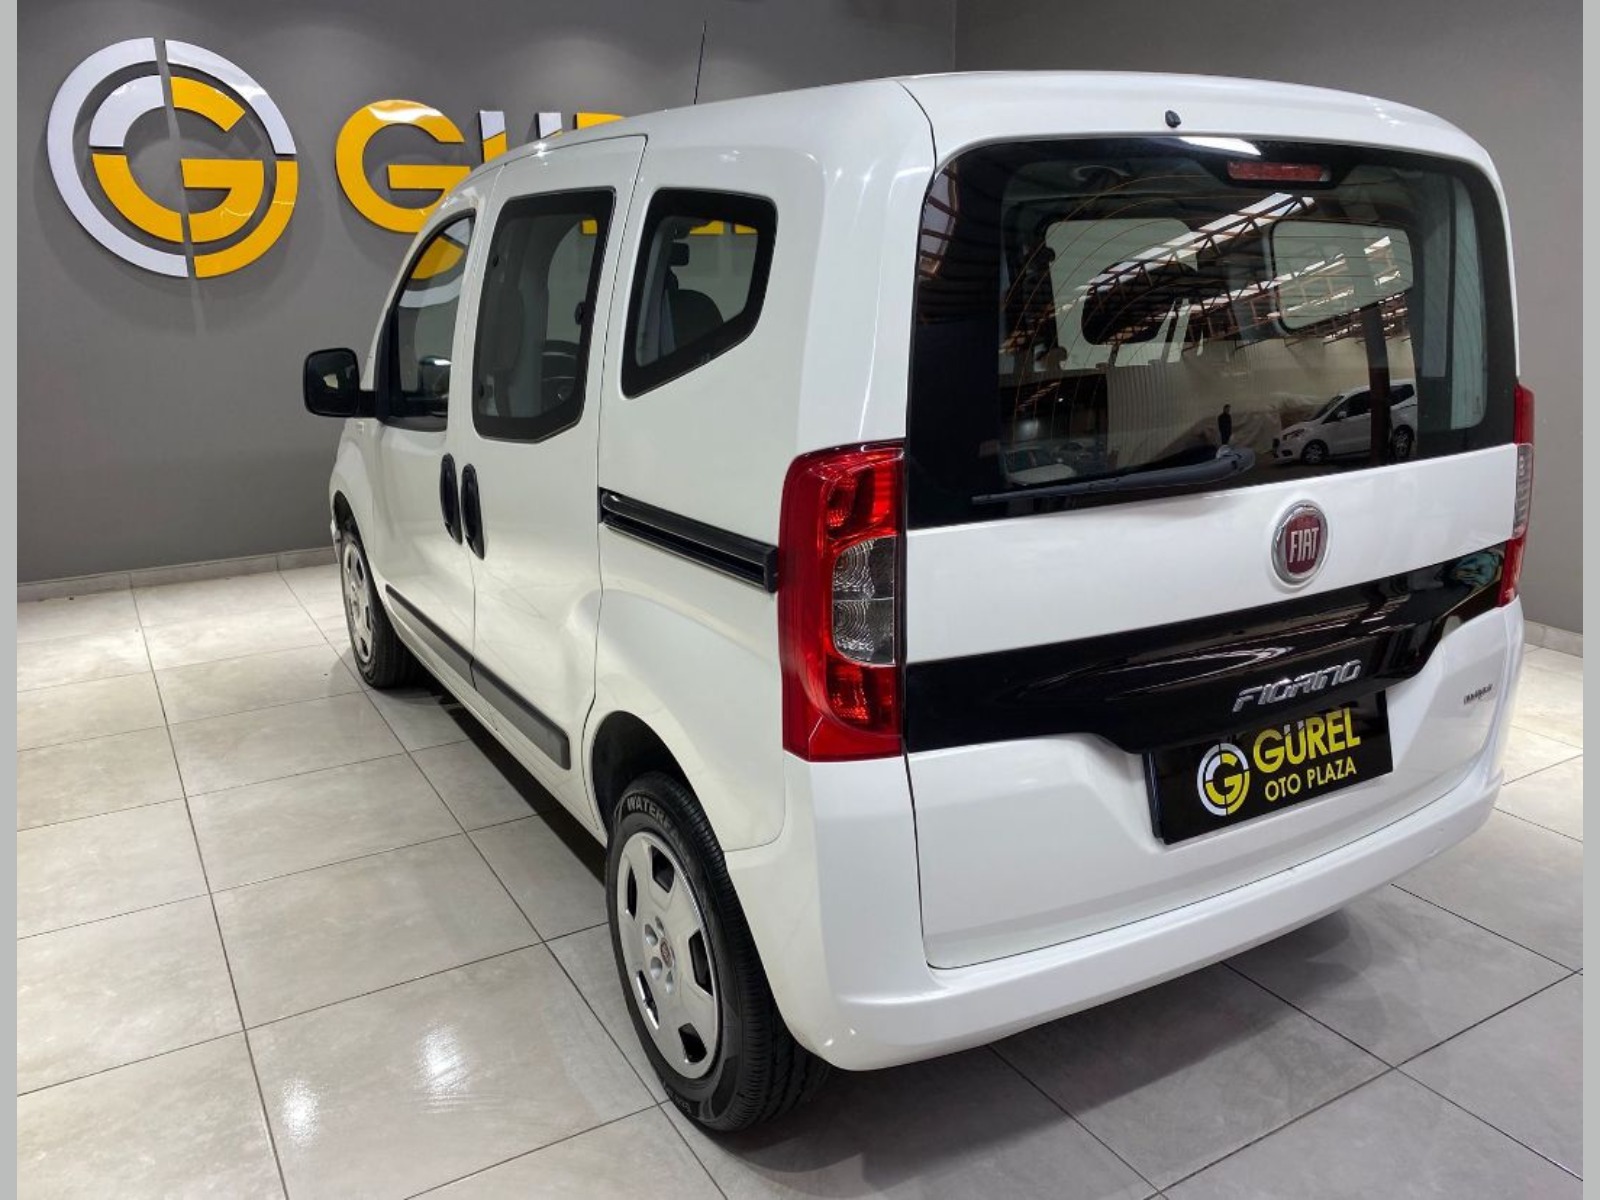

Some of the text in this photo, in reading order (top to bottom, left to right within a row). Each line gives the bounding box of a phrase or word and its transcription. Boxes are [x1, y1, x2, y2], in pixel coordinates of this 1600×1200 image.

[1289, 526, 1319, 563] FIAT
[1232, 659, 1363, 713] FIORINO
[1265, 756, 1357, 801] OTO PLAZA
